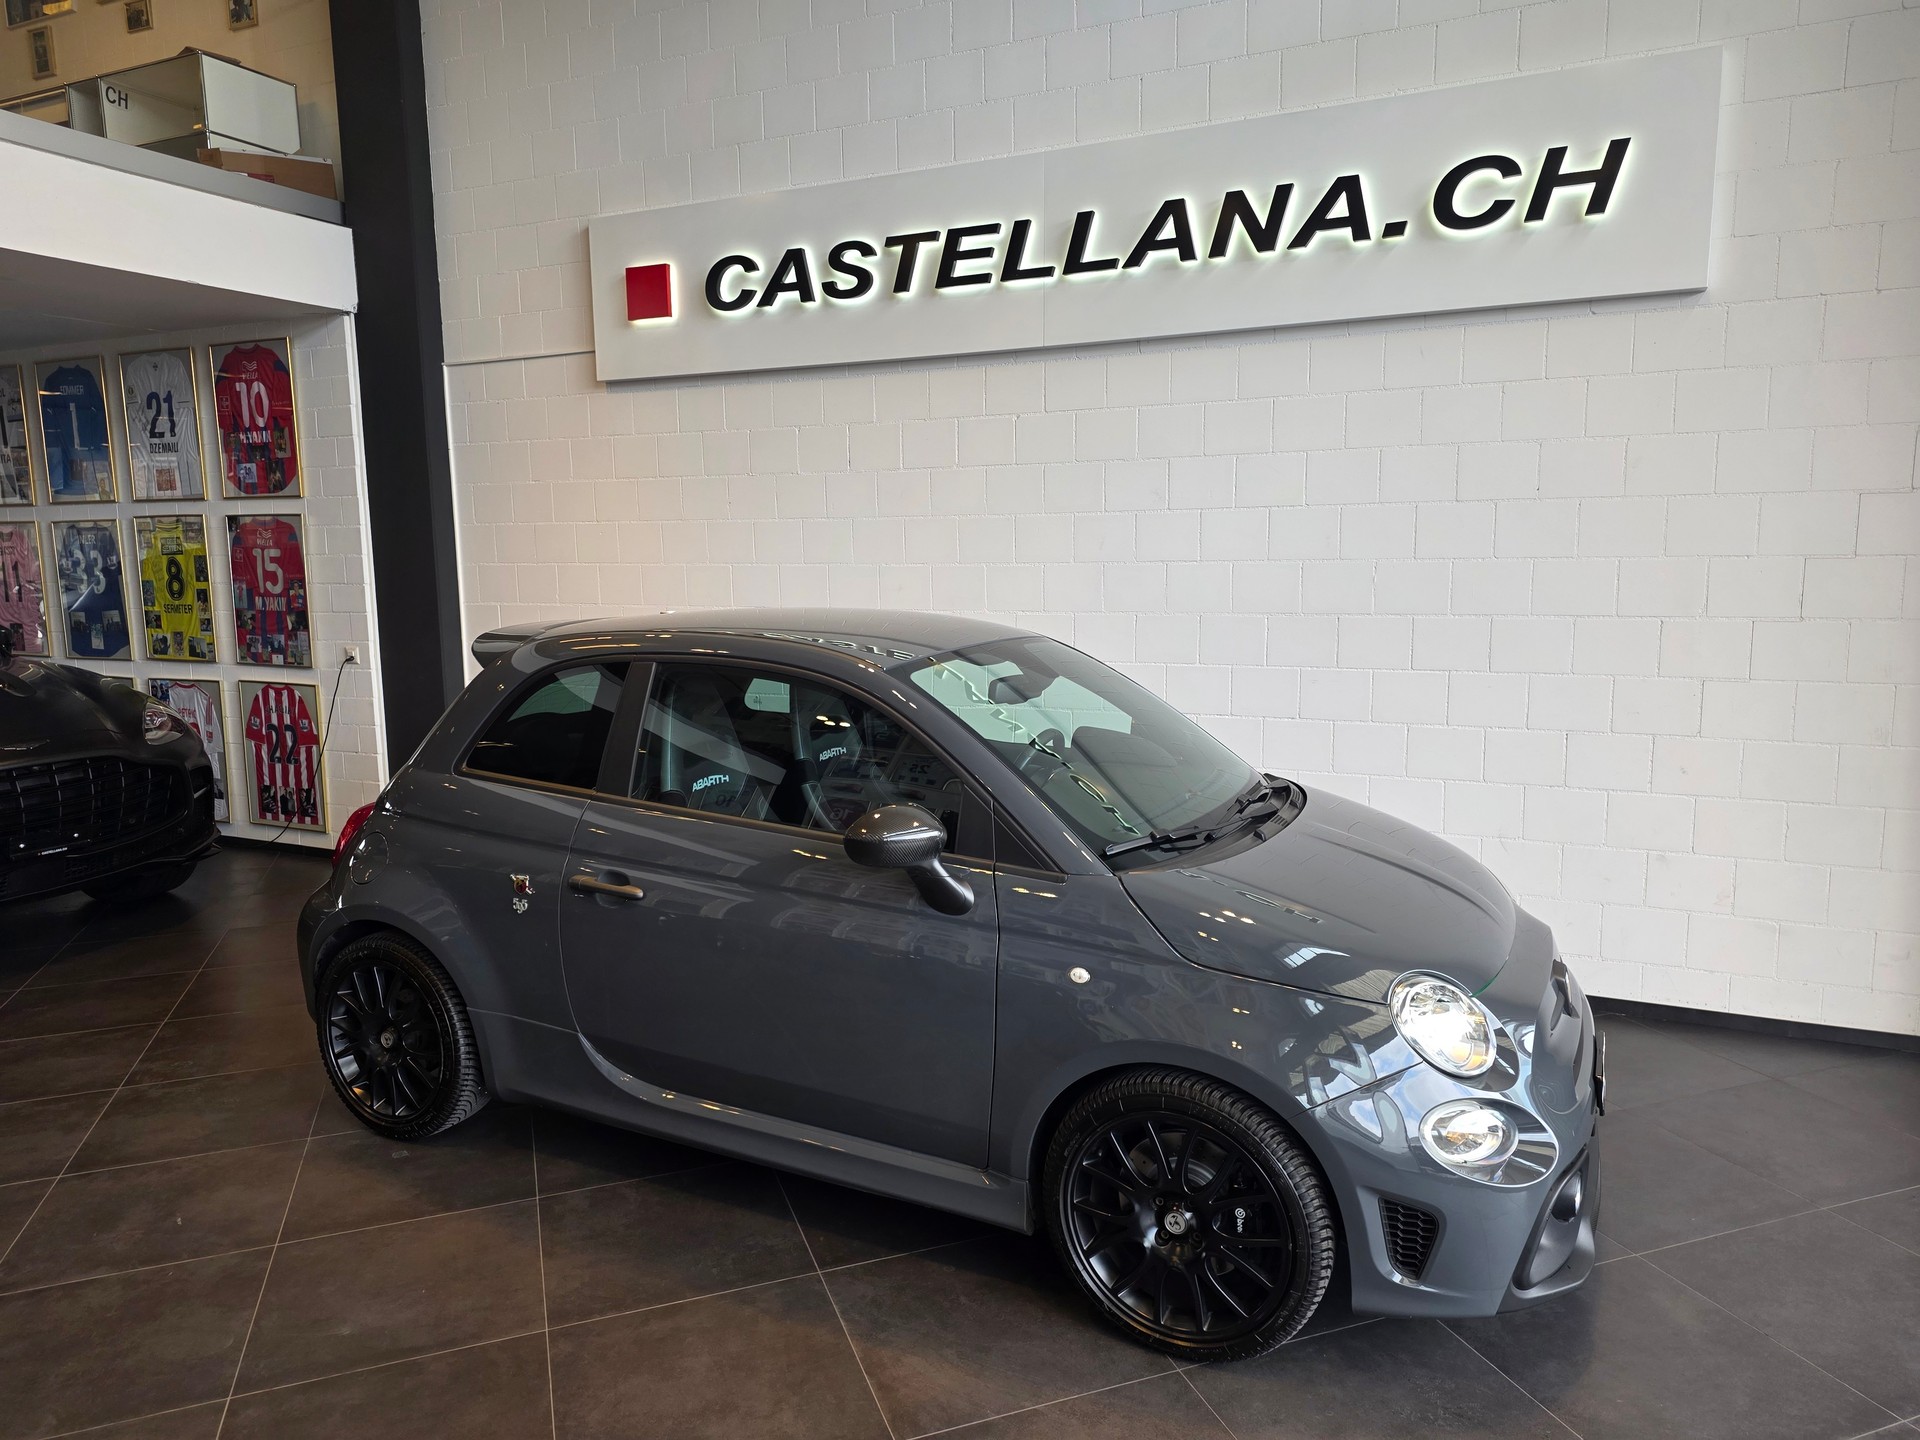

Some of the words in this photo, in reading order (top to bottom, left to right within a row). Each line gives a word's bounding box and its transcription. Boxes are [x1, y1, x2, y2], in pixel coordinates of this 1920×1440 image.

[105, 86, 129, 110] CH
[704, 136, 1632, 311] CASTELLANA.CH
[70, 403, 89, 451] 1
[146, 390, 177, 439] 21
[235, 381, 270, 428] 10
[73, 550, 107, 594] 33
[166, 556, 186, 601] 8
[252, 547, 284, 595] 15
[266, 723, 299, 765] 22
[819, 746, 847, 762] ABARTH
[692, 774, 730, 792] ABARTH
